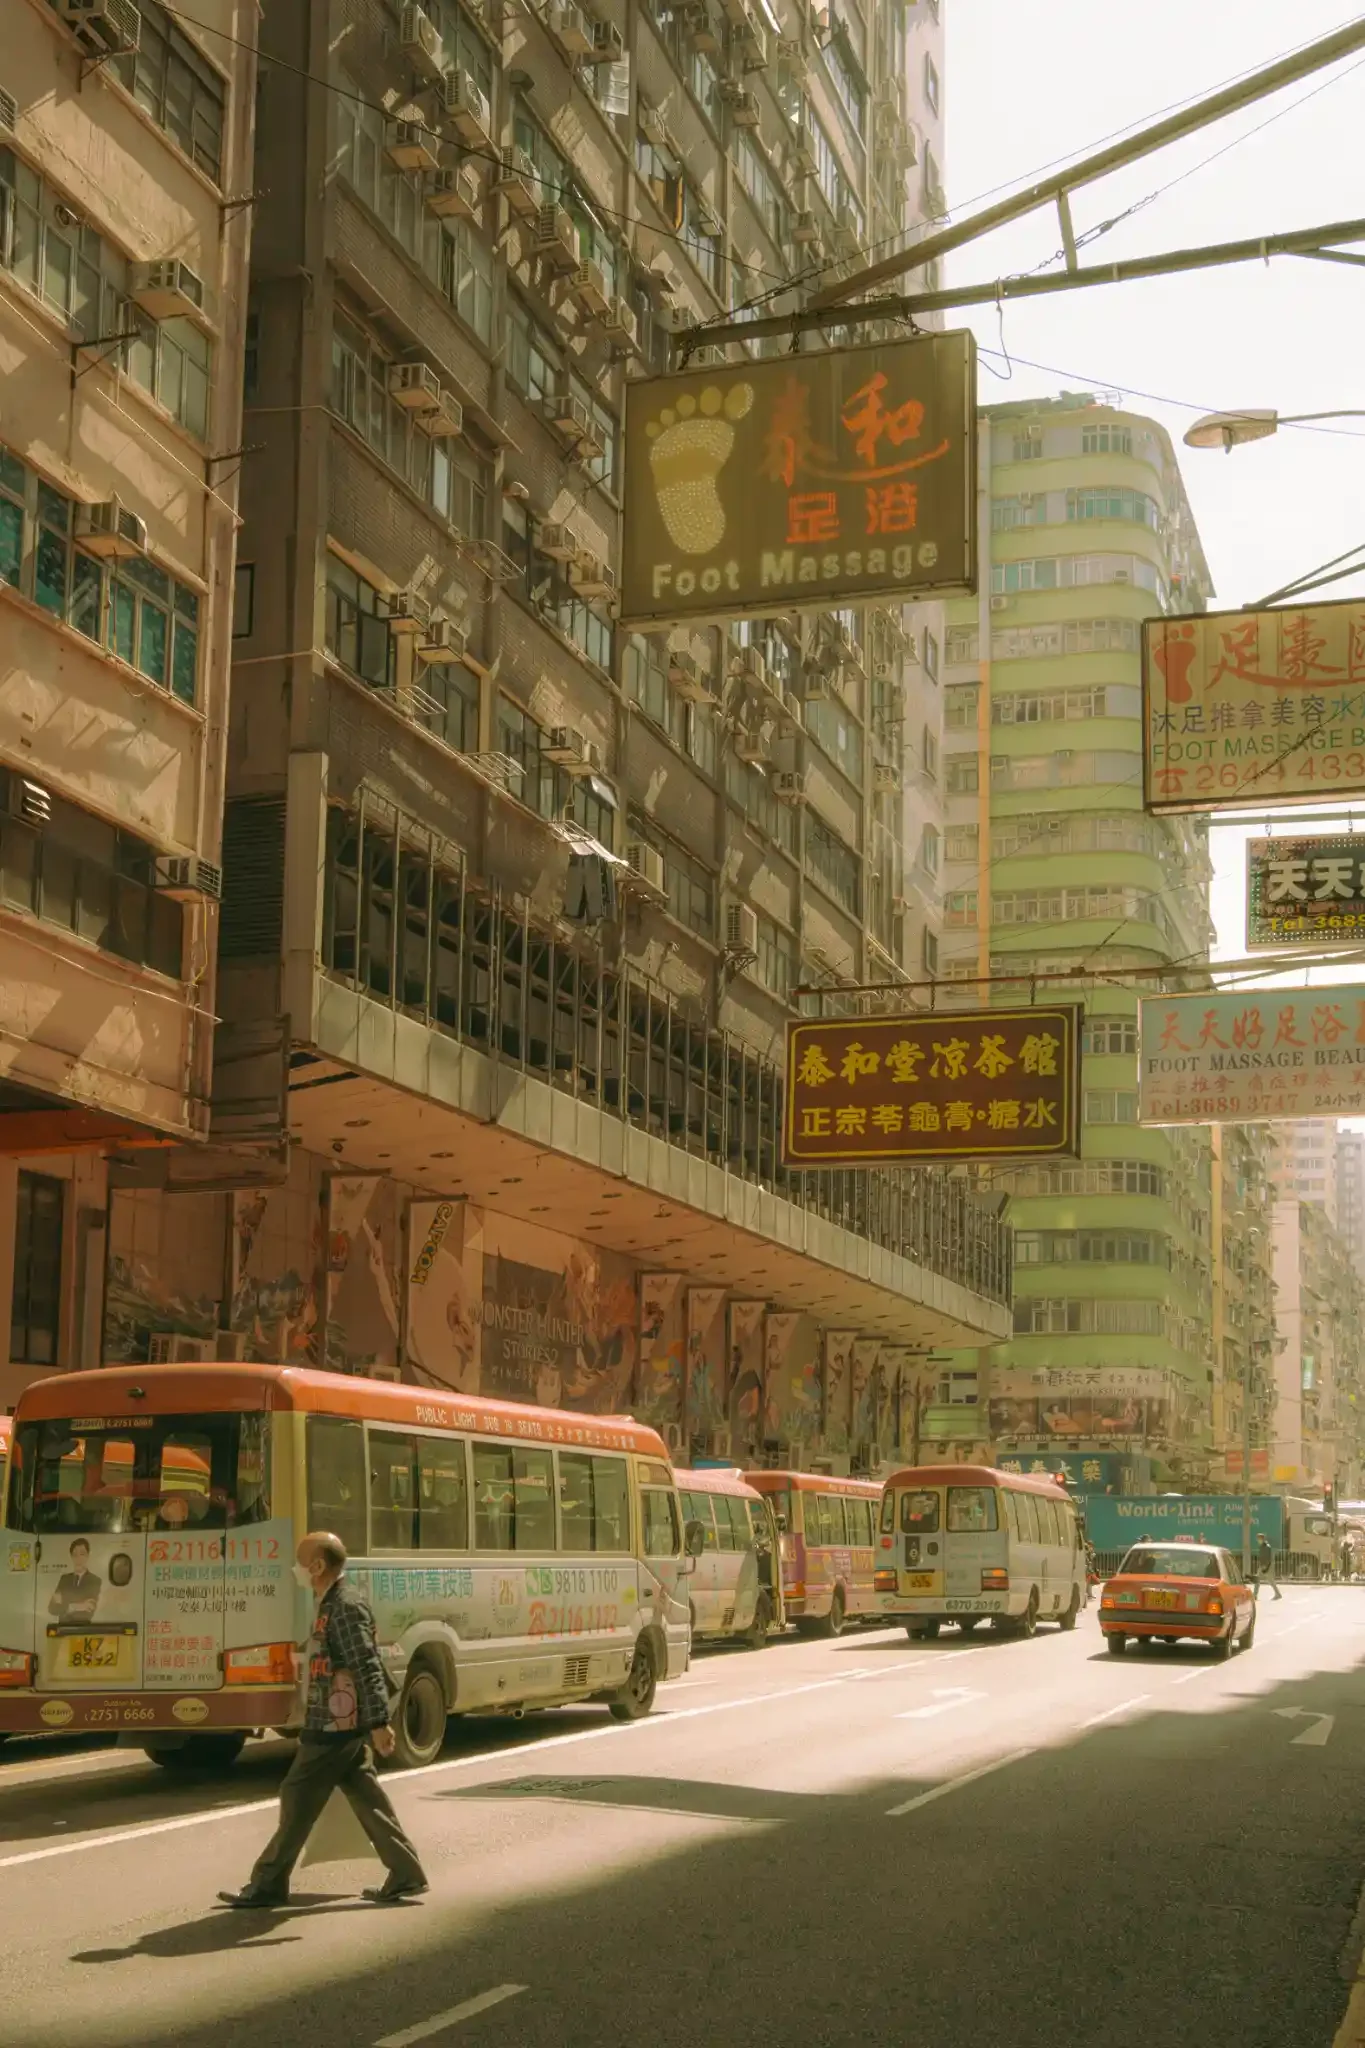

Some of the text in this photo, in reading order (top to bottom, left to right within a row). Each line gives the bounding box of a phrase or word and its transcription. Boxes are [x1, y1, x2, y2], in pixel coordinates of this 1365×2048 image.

[652, 541, 940, 599] Foot Massage
[1203, 614, 1365, 691] 足豪
[1152, 739, 1218, 763] FOOT
[1224, 728, 1344, 758] MASSAGE
[1267, 856, 1365, 902] 天天
[1158, 1001, 1365, 1051] 天天好足浴
[1147, 1055, 1200, 1074] FOOT
[1208, 1050, 1304, 1071] MASSAGE
[410, 1202, 453, 1286] CAPCOM
[472, 1300, 585, 1348] MONSTER HUNTER
[415, 1405, 448, 1424] PUBLIC
[452, 1411, 477, 1429] LIGHT
[1224, 1503, 1259, 1513] Alwys
[172, 1537, 280, 1562] 2116 1112
[554, 1569, 618, 1594] 9818 1100
[90, 1707, 156, 1722] 2751 6666
